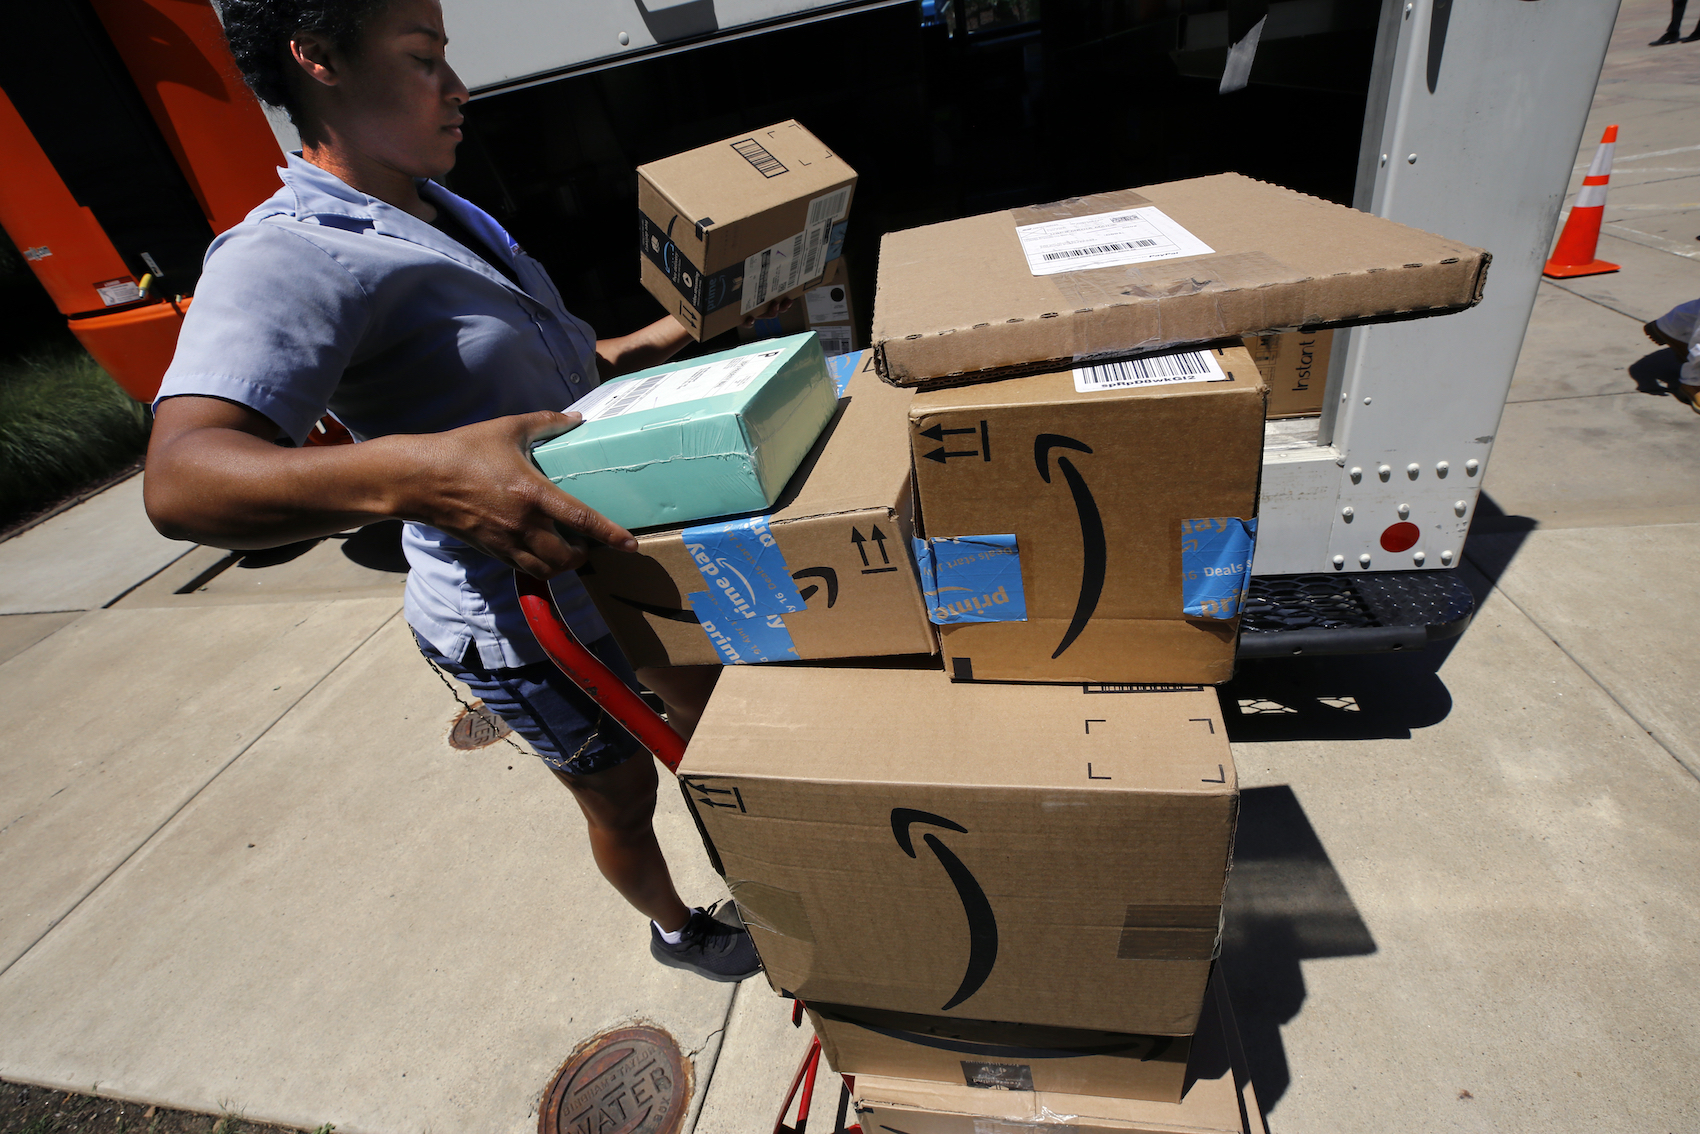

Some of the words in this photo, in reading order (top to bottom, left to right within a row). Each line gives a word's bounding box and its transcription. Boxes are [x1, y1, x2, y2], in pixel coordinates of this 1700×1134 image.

[705, 277, 718, 312] prime
[1292, 339, 1316, 391] Instant
[685, 543, 720, 576] day
[736, 543, 757, 565] start
[946, 555, 976, 569] start
[978, 547, 1013, 560] Deals
[754, 565, 777, 590] Deals
[1204, 563, 1244, 577] Deals
[775, 592, 788, 605] 16
[935, 585, 1010, 619] prime
